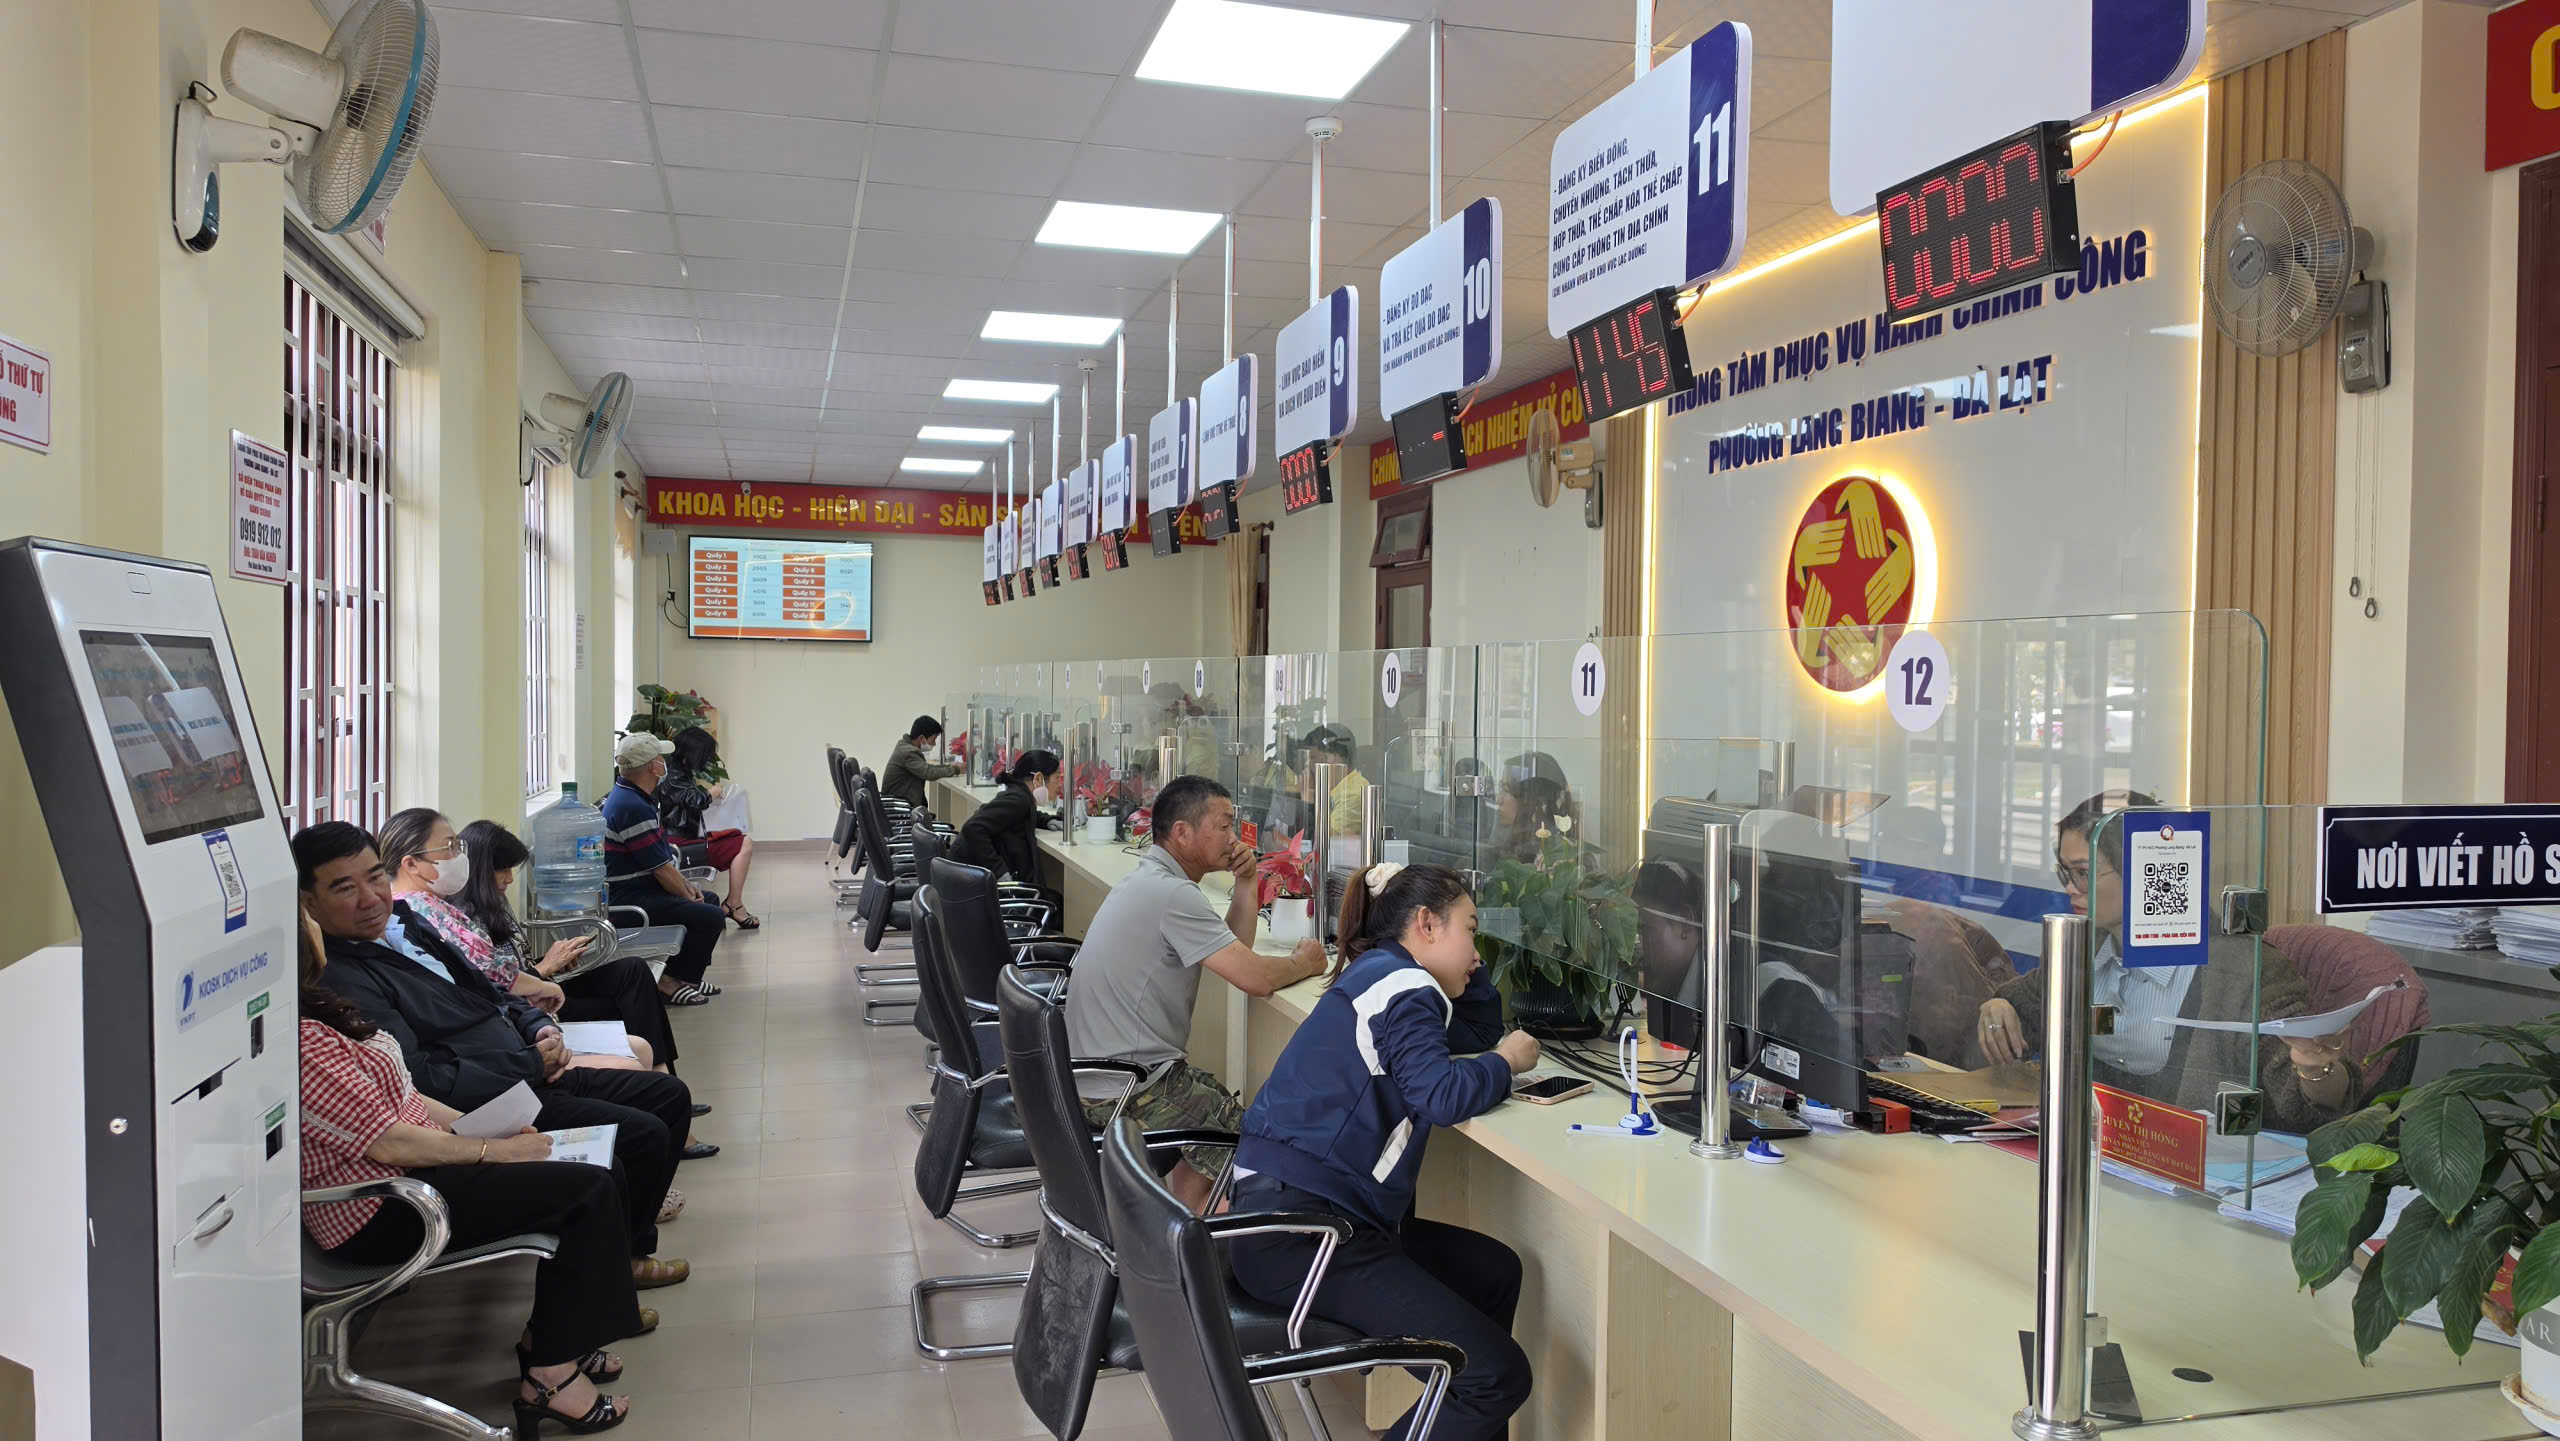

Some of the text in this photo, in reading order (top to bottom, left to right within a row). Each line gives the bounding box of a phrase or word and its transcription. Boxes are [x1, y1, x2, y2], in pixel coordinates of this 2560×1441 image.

[1693, 101, 1731, 196] 11
[1558, 169, 1576, 195] ĐĂNG
[1578, 159, 1587, 183] KÝ
[1613, 165, 1633, 190] TÁCH
[1553, 203, 1669, 279] CUNG CẤP THÔNG TIN ĐỊA CHÍNH
[1464, 257, 1491, 325] 10
[1728, 352, 1767, 396] TÂM
[1773, 332, 1829, 383] PHỤC
[1836, 318, 1866, 366] VỤ
[2054, 229, 2147, 300] CÔNG
[1334, 336, 1344, 386] 9
[1573, 300, 1669, 415] 1145
[7, 362, 44, 398] THỨ TỰ
[1240, 395, 1246, 437] 8
[1487, 400, 1533, 450] NHIỆM
[1709, 421, 1784, 474] PHƯỜNG
[1790, 408, 1843, 456] LANG
[1850, 388, 1925, 442] BIANG
[1952, 365, 1989, 420] ĐÀ
[2000, 355, 2052, 414] LẠT
[1181, 433, 1187, 469] 7
[1088, 486, 1092, 514] 5
[1125, 465, 1130, 496] 6
[658, 490, 726, 517] KHOA
[734, 494, 784, 523] HỌC
[809, 494, 867, 527] HIỆN
[875, 500, 914, 528] ĐẠI
[240, 517, 281, 549] 0919 912 012
[1275, 669, 1284, 692] 09
[1386, 667, 1397, 694] 10
[1581, 663, 1596, 696] 11
[1901, 657, 1933, 705] 12
[2357, 841, 2408, 889] NƠI
[2417, 832, 2483, 887] VIẾT
[2492, 832, 2535, 885] HỒ
[199, 951, 268, 999] KIOSK DỊCH VỤ CÔNG
[2133, 1123, 2148, 1140] THỊ
